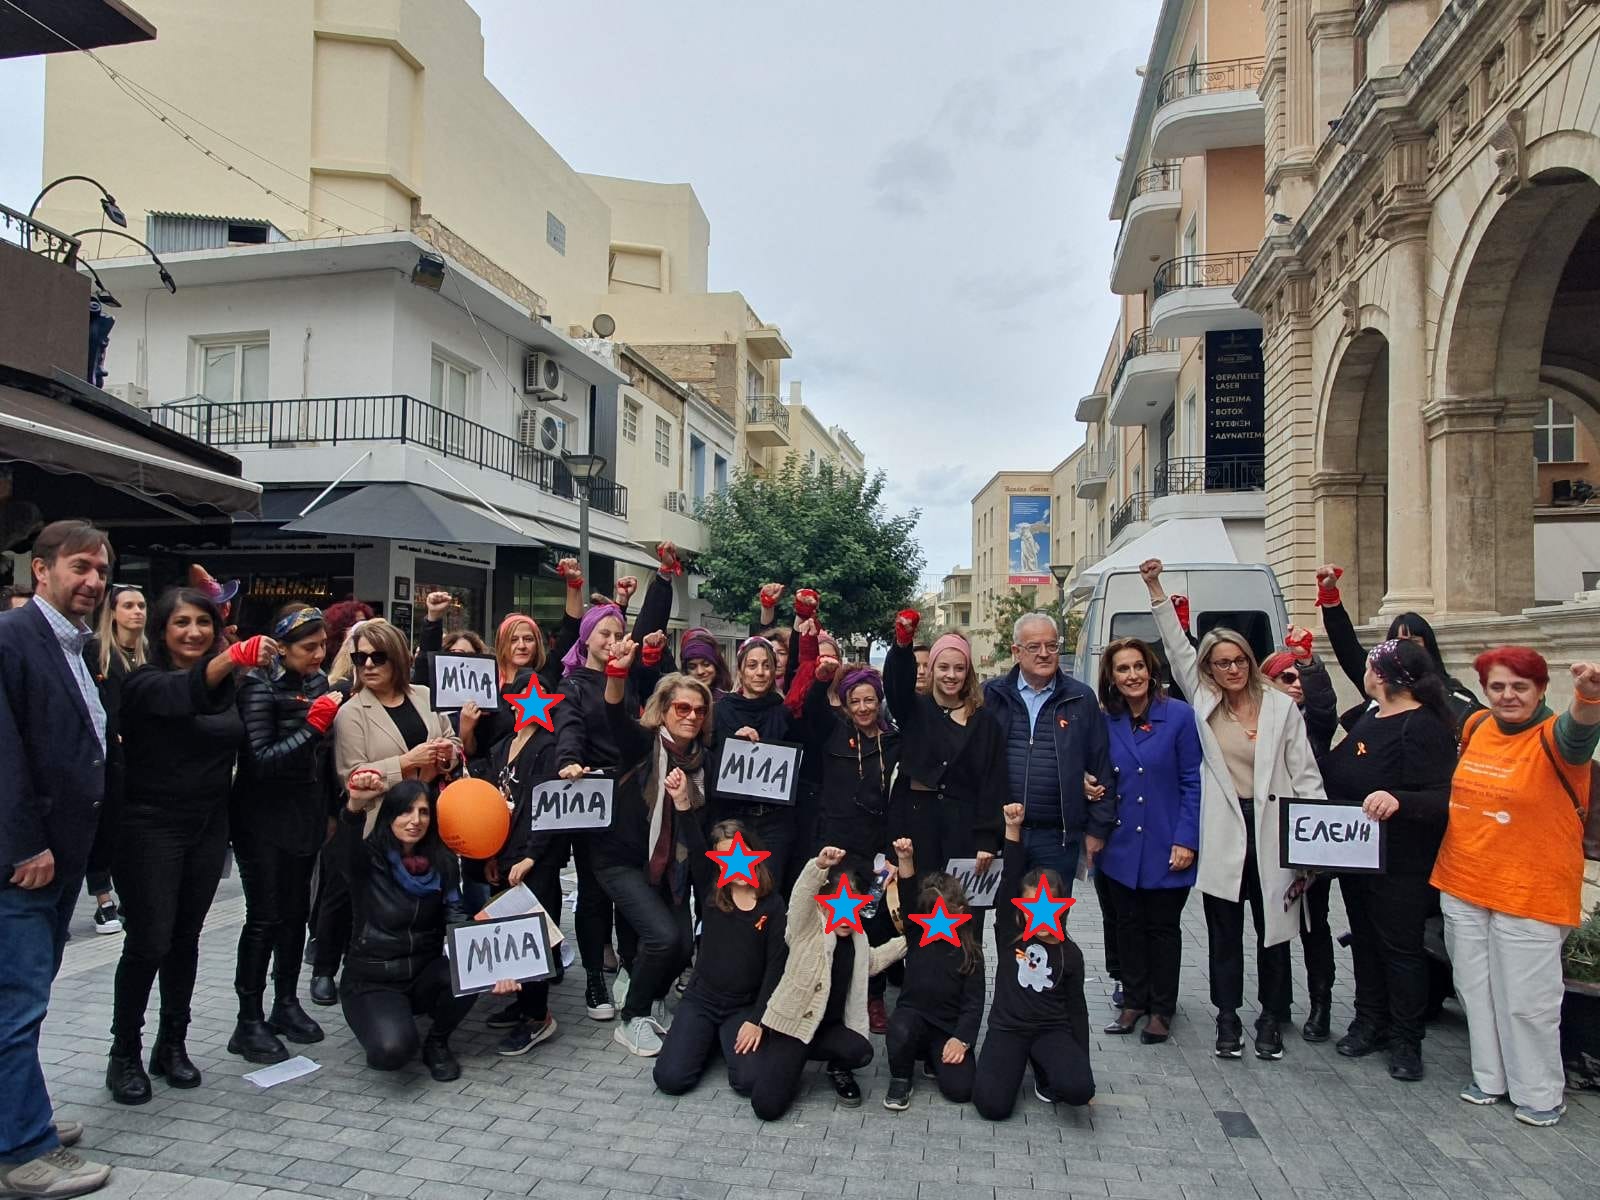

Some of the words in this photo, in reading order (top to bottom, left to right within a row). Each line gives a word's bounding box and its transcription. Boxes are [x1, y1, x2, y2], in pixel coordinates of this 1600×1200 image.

[1215, 373, 1260, 381] ΘΕΡΑΠΕΙΕΣ
[1215, 382, 1240, 390] LASER
[1215, 420, 1251, 428] ΣΥΣΦΙΞΗ
[1294, 816, 1371, 842] ΕΛΕΝΗ
